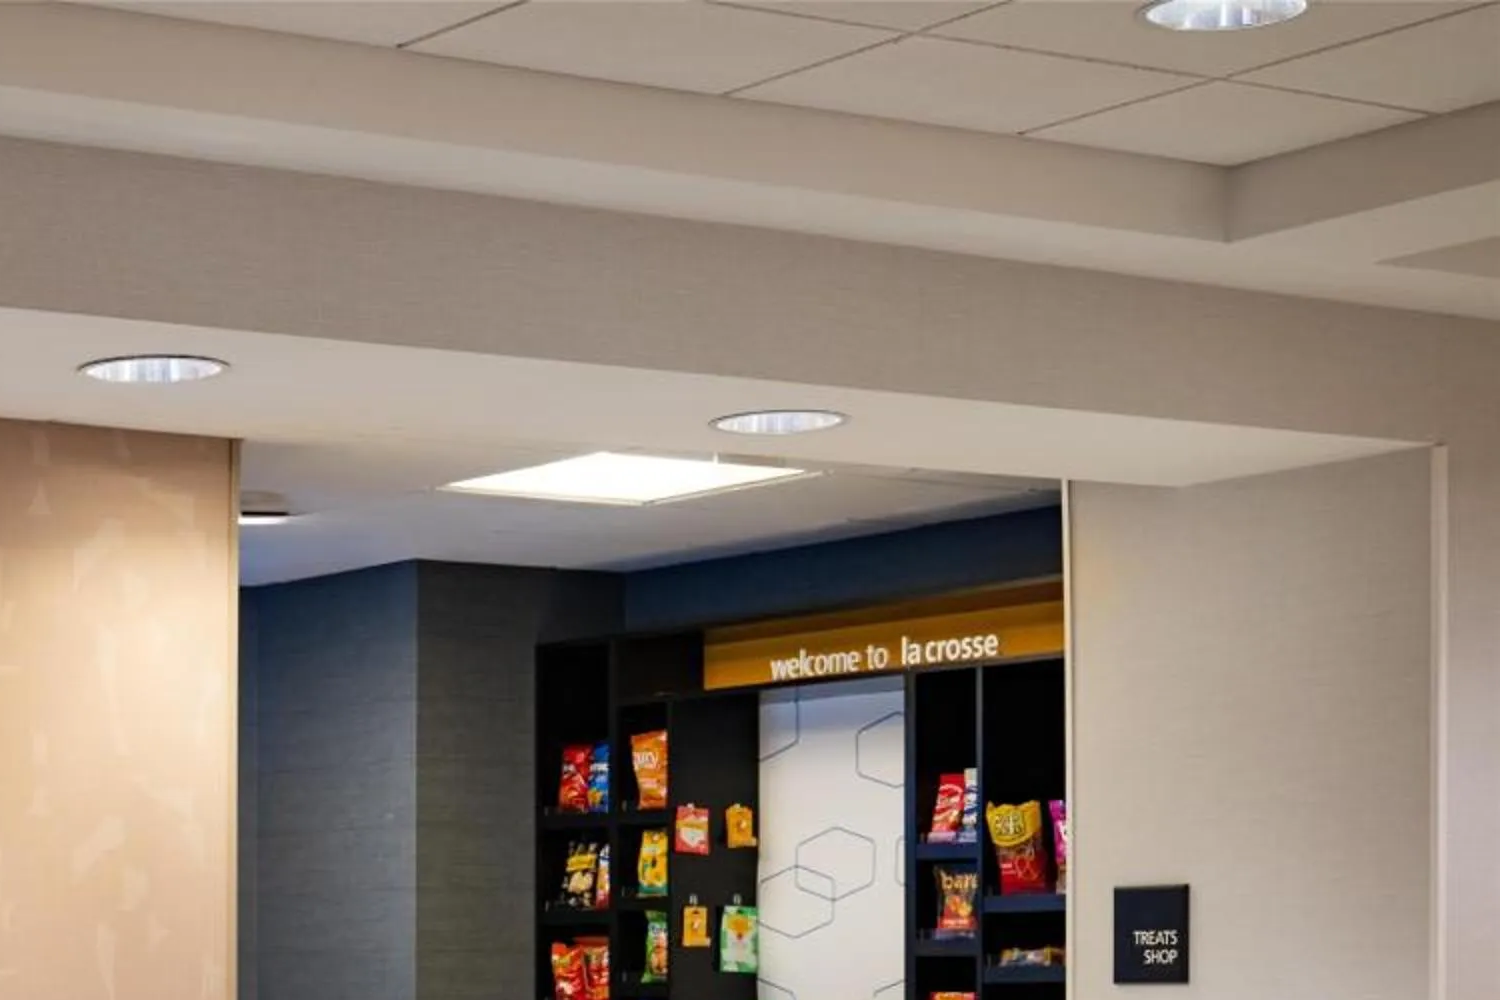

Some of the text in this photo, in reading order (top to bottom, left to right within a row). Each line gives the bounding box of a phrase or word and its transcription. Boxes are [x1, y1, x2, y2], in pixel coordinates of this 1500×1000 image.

[770, 633, 999, 681] welcome to la crosse
[1133, 929, 1179, 945] TREATS
[1143, 949, 1178, 965] SHOP
